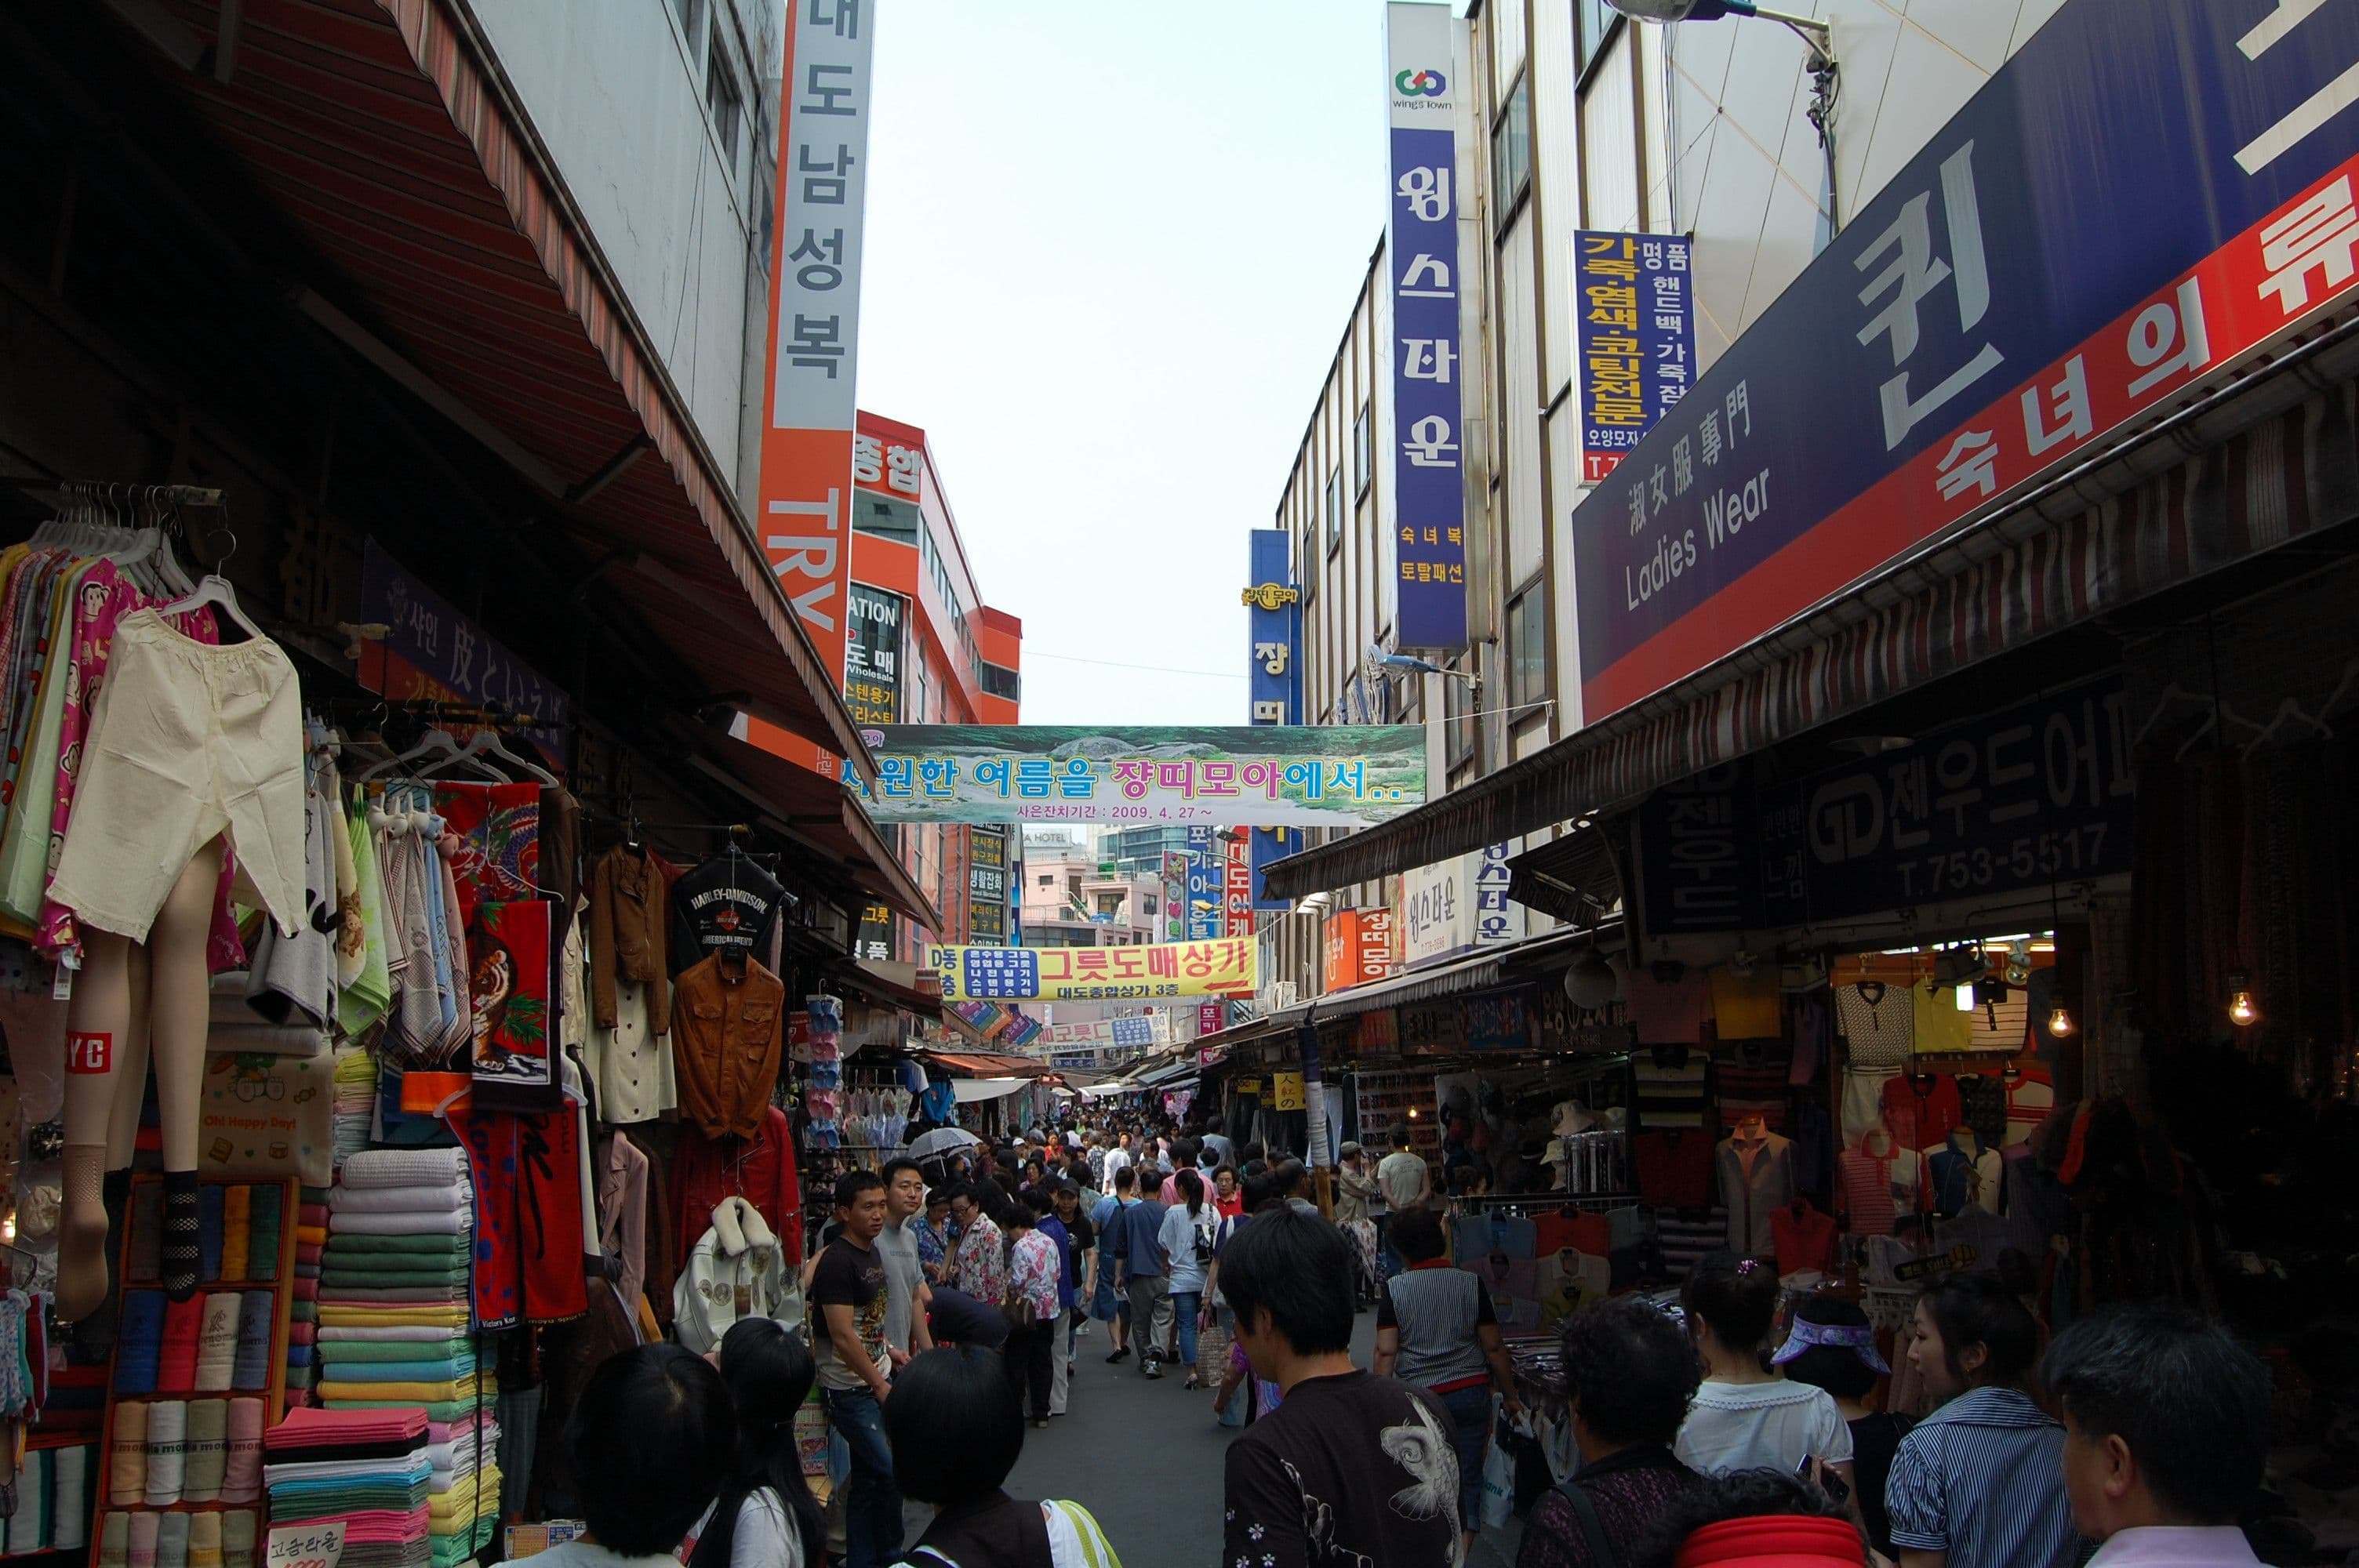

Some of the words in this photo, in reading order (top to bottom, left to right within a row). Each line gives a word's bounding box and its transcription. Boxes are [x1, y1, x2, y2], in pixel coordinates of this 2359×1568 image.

[1643, 242, 1688, 271] 명품
[1854, 139, 2005, 452] 퀸
[1396, 166, 1459, 467] 윙스타운
[1653, 276, 1688, 421] 핸드백·가죽잠
[1628, 379, 1751, 537] 淑女服專門
[767, 488, 839, 633] TRY
[1626, 528, 1696, 612] Ladies
[1703, 468, 1769, 550] Wear
[846, 664, 894, 683] Wholesale
[841, 757, 959, 798] 시원한
[973, 757, 1098, 798] 여름을
[1016, 805, 1096, 818] 사은잔치기간
[1035, 833, 1066, 843] HOTEL
[690, 888, 768, 914] HARLEY-DAVIDSON
[1410, 876, 1456, 944] 윙스타운
[931, 949, 957, 970] D동
[1041, 940, 1248, 982] 그릇도매상가
[1056, 985, 1150, 1000] 대도종합상가
[1156, 983, 1180, 996] 3층
[205, 1116, 225, 1127] Oh!
[229, 1116, 267, 1130] Happy
[271, 1116, 296, 1130] Day!
